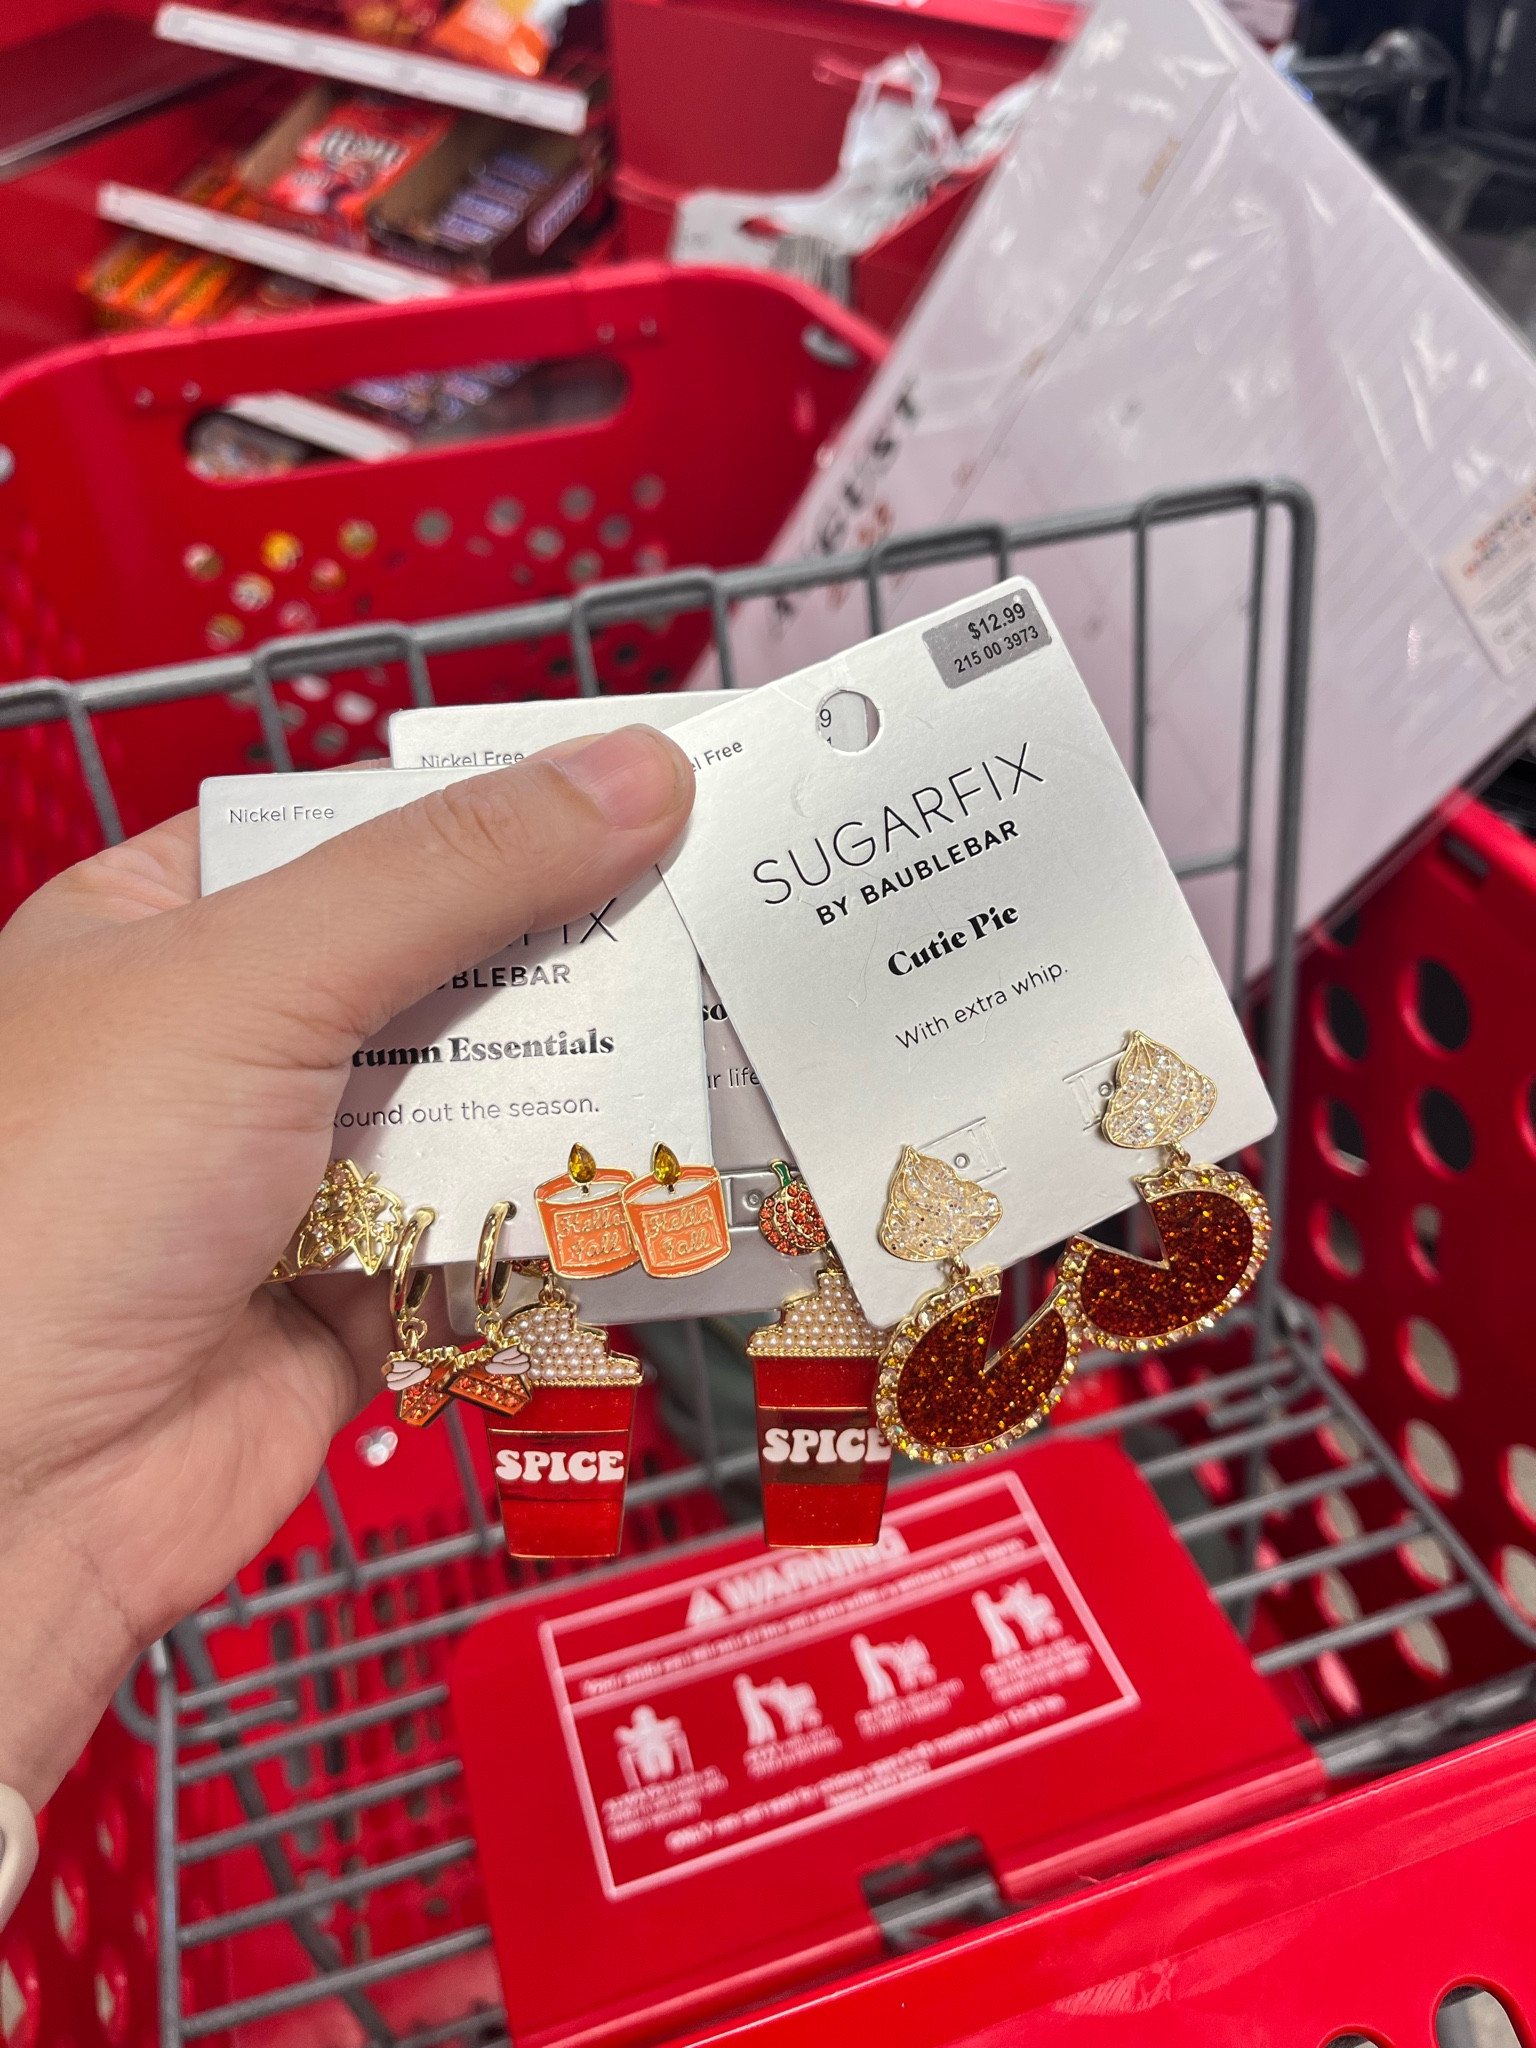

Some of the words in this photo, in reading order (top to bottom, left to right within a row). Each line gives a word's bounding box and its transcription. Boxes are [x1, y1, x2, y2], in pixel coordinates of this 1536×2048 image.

[967, 602, 1026, 640] $12.99
[954, 651, 982, 673] 215
[983, 642, 1002, 659] 00
[1004, 625, 1039, 650] 3973
[484, 751, 525, 766] Free
[704, 741, 744, 766] Free
[229, 807, 286, 824] Nickel
[293, 806, 335, 820] Free
[752, 741, 1045, 905] SUGARFIX
[815, 896, 849, 926] BY
[859, 819, 1020, 905] BAUBLEBAR
[887, 930, 969, 976] Cutie
[968, 904, 1020, 941] Pie
[437, 964, 571, 990] BLEBAR
[895, 1016, 950, 1050] With
[954, 991, 1009, 1024] extra
[1011, 963, 1069, 998] whip.
[352, 1044, 443, 1068] tumn
[450, 1028, 615, 1062] Essentials
[412, 1103, 453, 1123] out
[461, 1100, 501, 1121] the
[509, 1096, 600, 1117] season.
[556, 1207, 627, 1238] Hello
[645, 1205, 714, 1238] Hello
[570, 1229, 622, 1261] Fall
[660, 1228, 710, 1261] Fall
[762, 1426, 892, 1463] SPICE
[495, 1449, 625, 1482] SPICE
